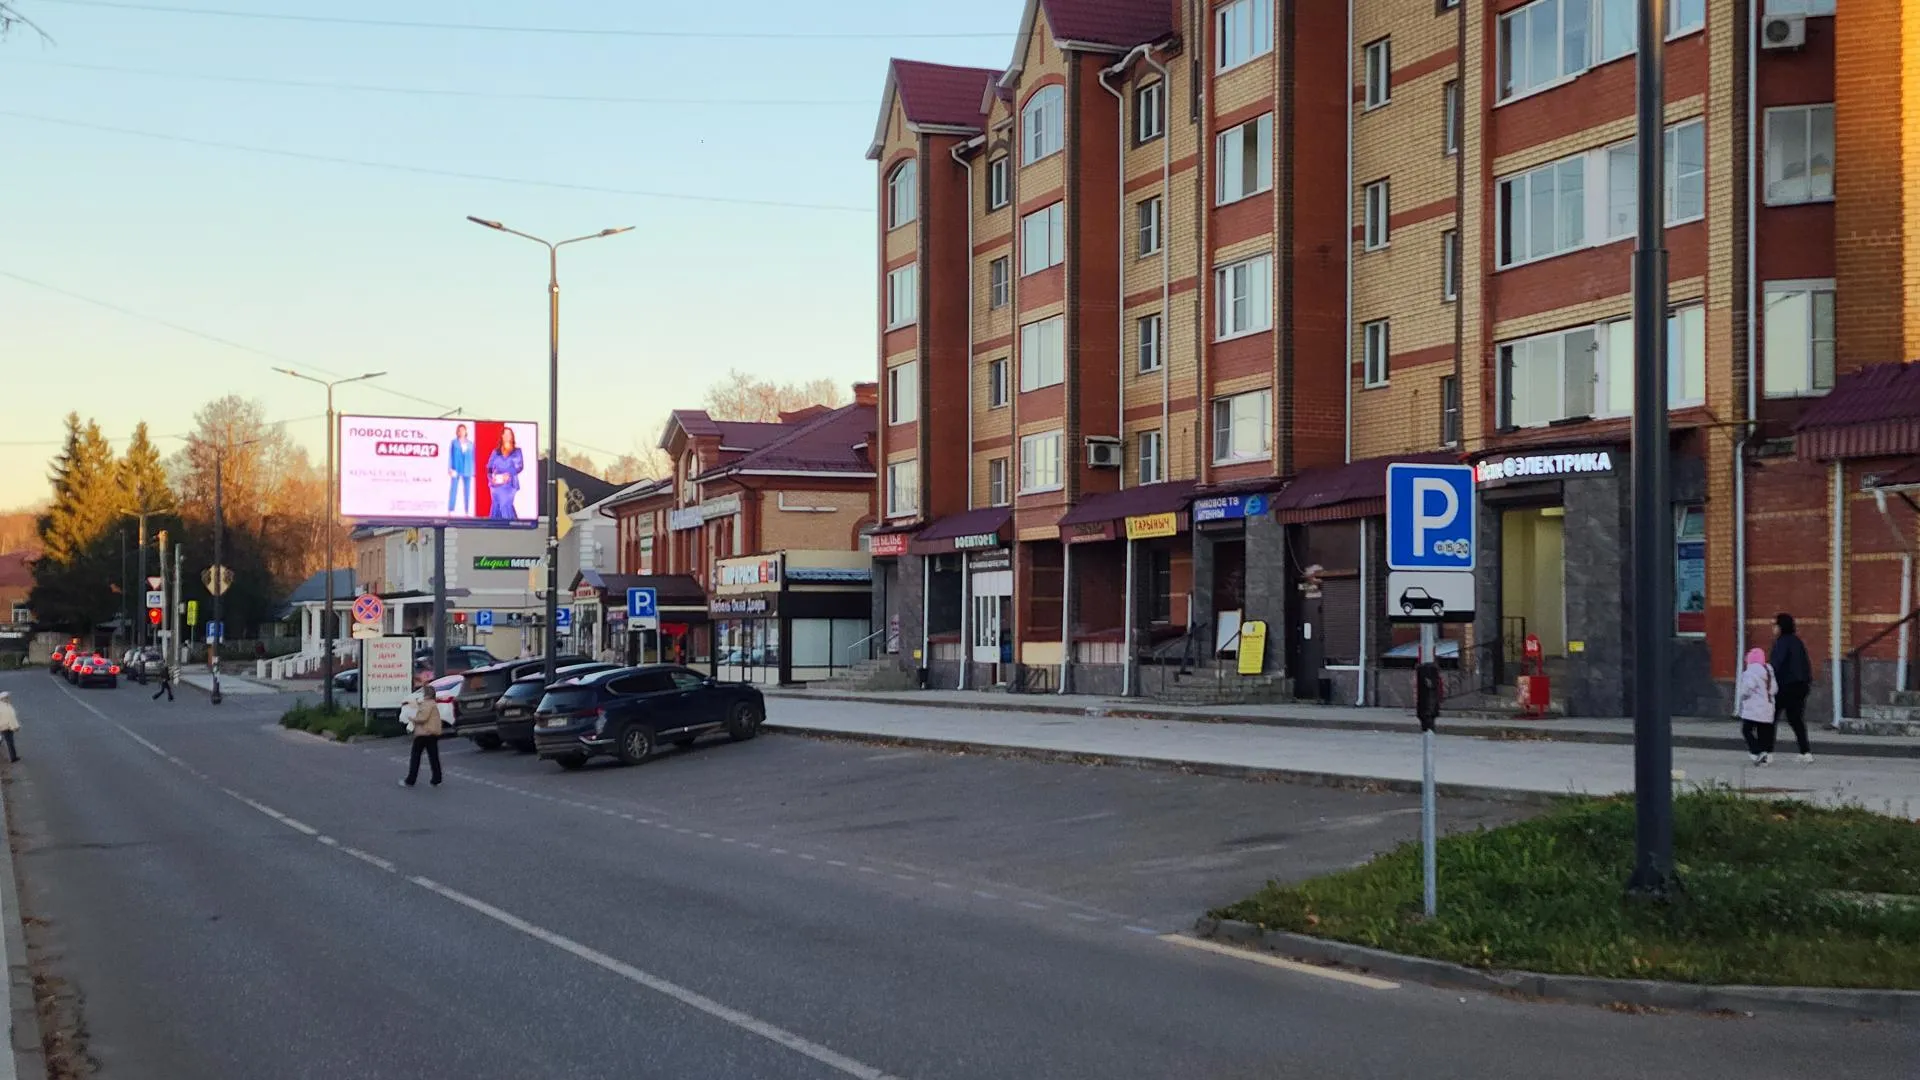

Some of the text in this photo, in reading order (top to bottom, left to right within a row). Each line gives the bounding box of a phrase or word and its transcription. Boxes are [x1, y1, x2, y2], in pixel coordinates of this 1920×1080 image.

[349, 427, 392, 439] ПОВОД
[377, 443, 437, 457] А НАРЯД?
[1515, 452, 1612, 475] ЭЛЕКТРИКА
[1133, 517, 1170, 531] ГАРЫНЫЧ
[711, 599, 731, 613] Мебель
[732, 598, 746, 612] Окна
